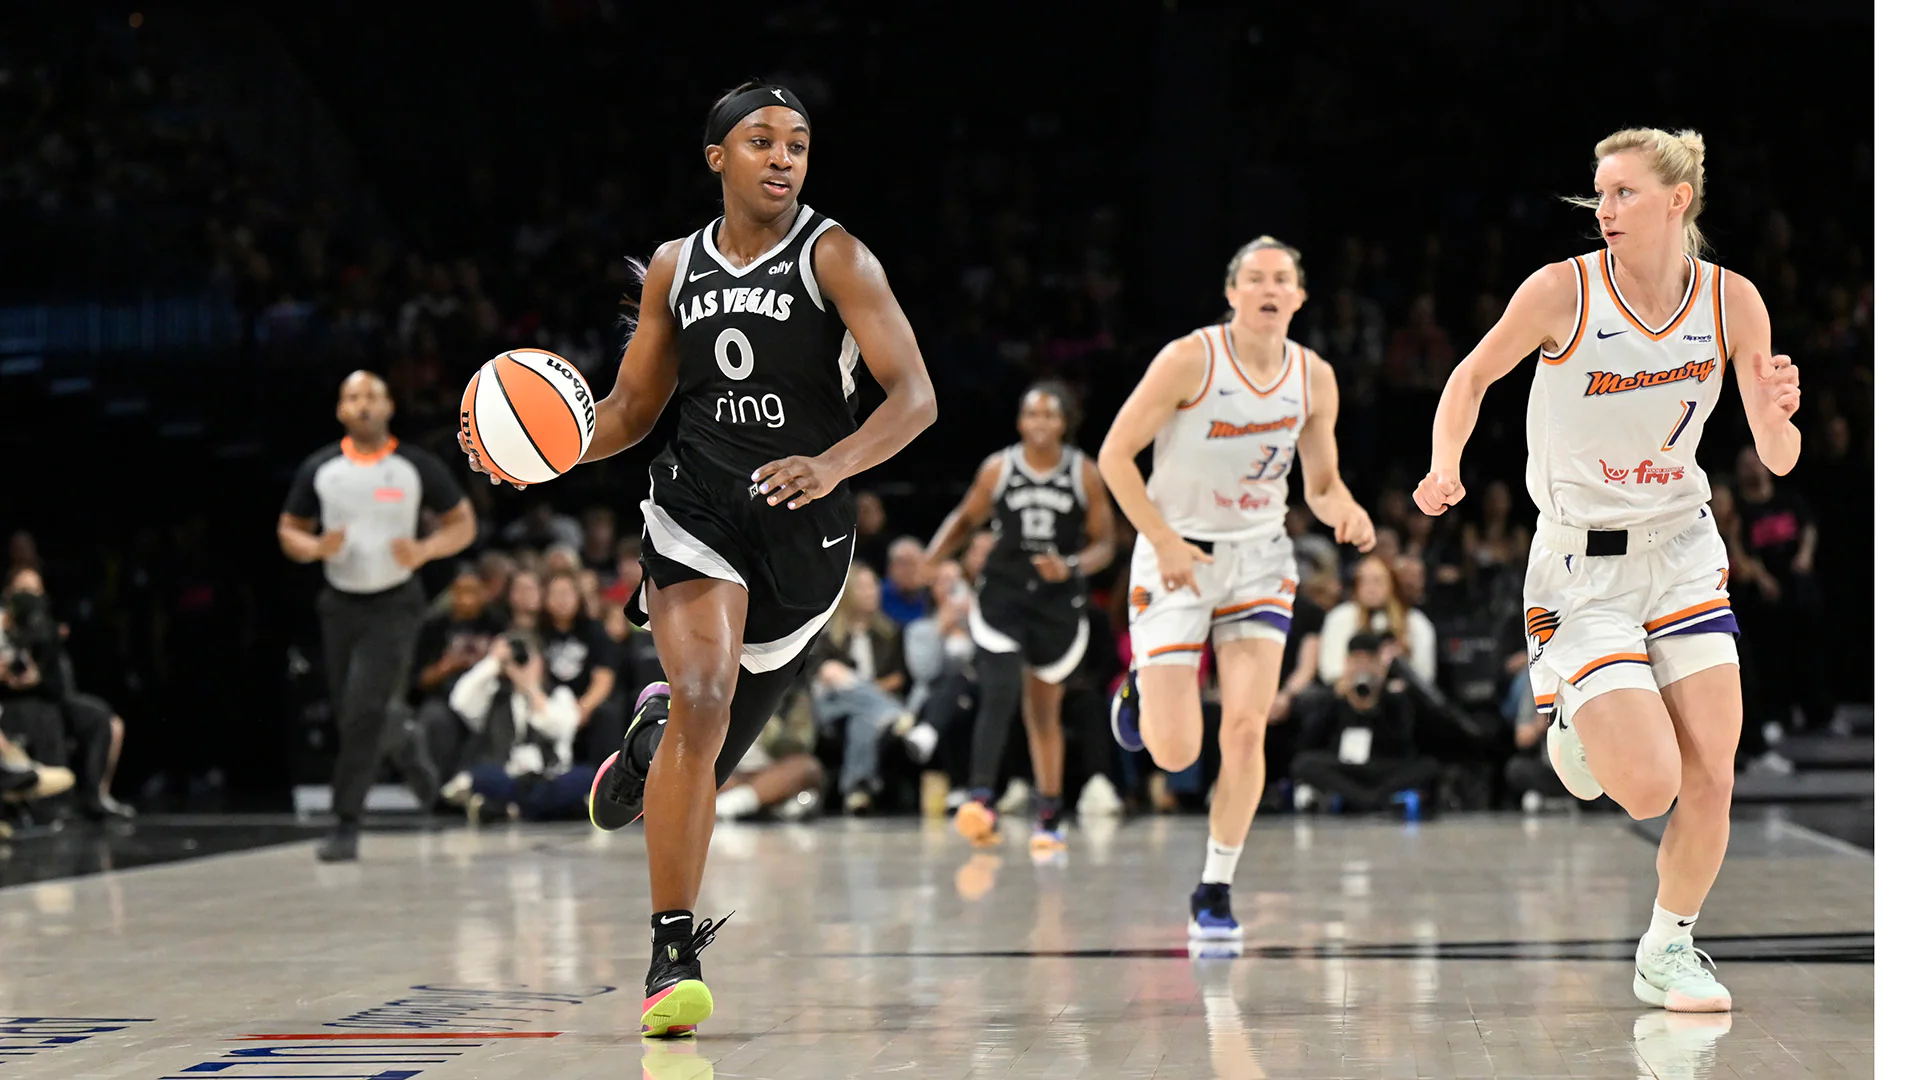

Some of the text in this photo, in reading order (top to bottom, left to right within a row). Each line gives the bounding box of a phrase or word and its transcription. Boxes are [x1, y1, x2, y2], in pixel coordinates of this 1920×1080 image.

[768, 261, 794, 276] ally
[679, 287, 795, 330] LAS VEGAS
[714, 327, 755, 381] 0
[546, 357, 596, 437] Wilson
[1584, 357, 1717, 398] Mercury
[715, 390, 786, 428] ring
